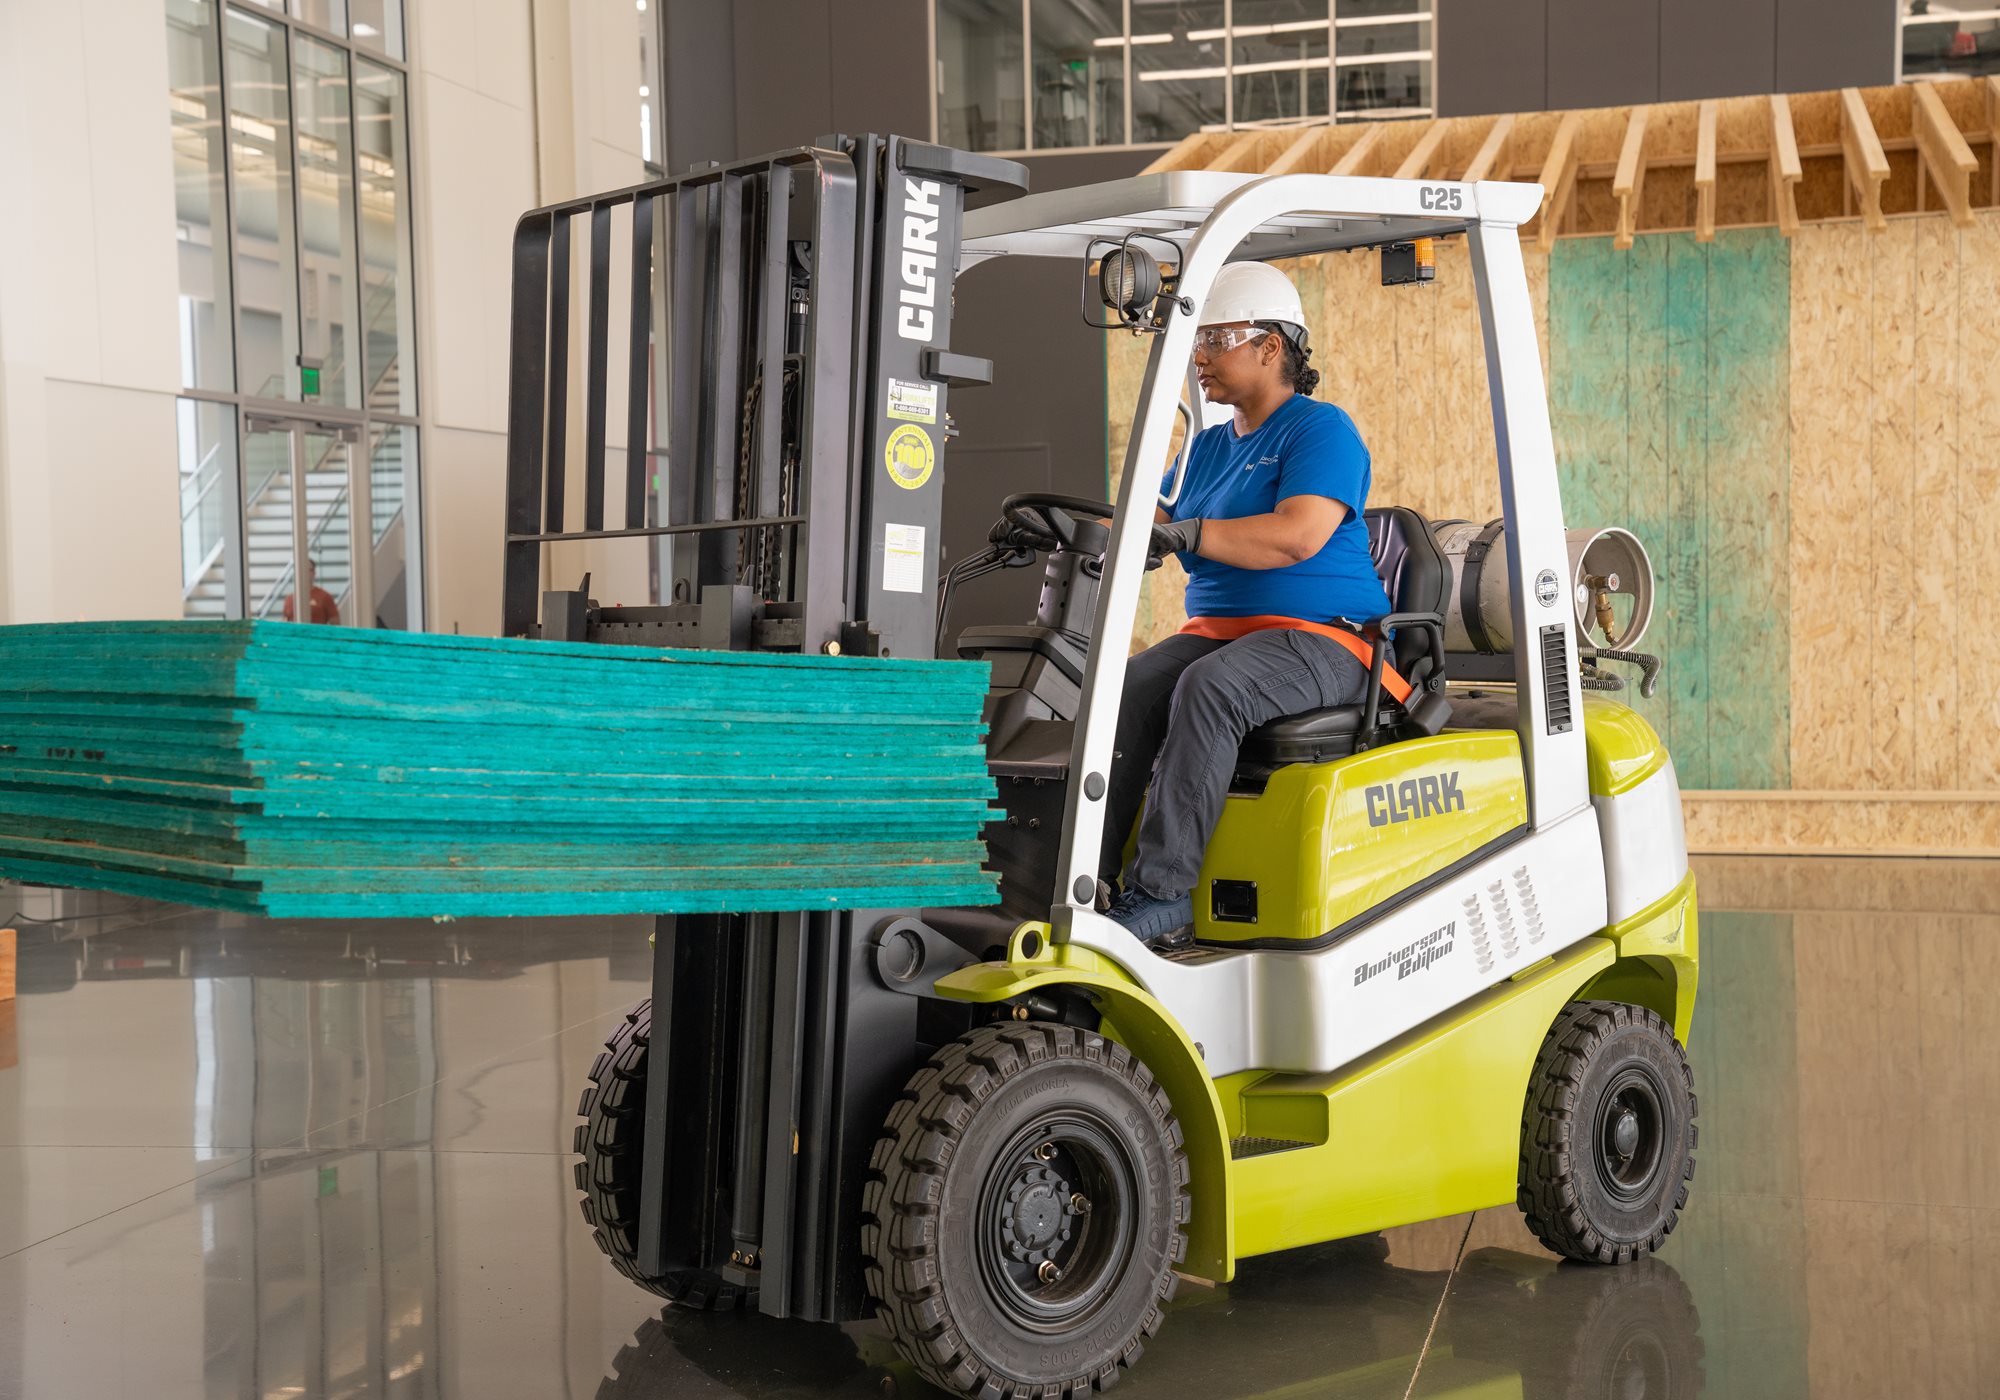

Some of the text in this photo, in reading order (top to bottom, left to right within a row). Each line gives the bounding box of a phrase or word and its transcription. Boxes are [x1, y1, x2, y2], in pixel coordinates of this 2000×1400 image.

[1420, 187, 1462, 211] C25
[898, 178, 940, 342] CLARK
[895, 443, 926, 469] 100
[1364, 771, 1465, 828] CLARK
[1034, 1078, 1070, 1094] KOREA
